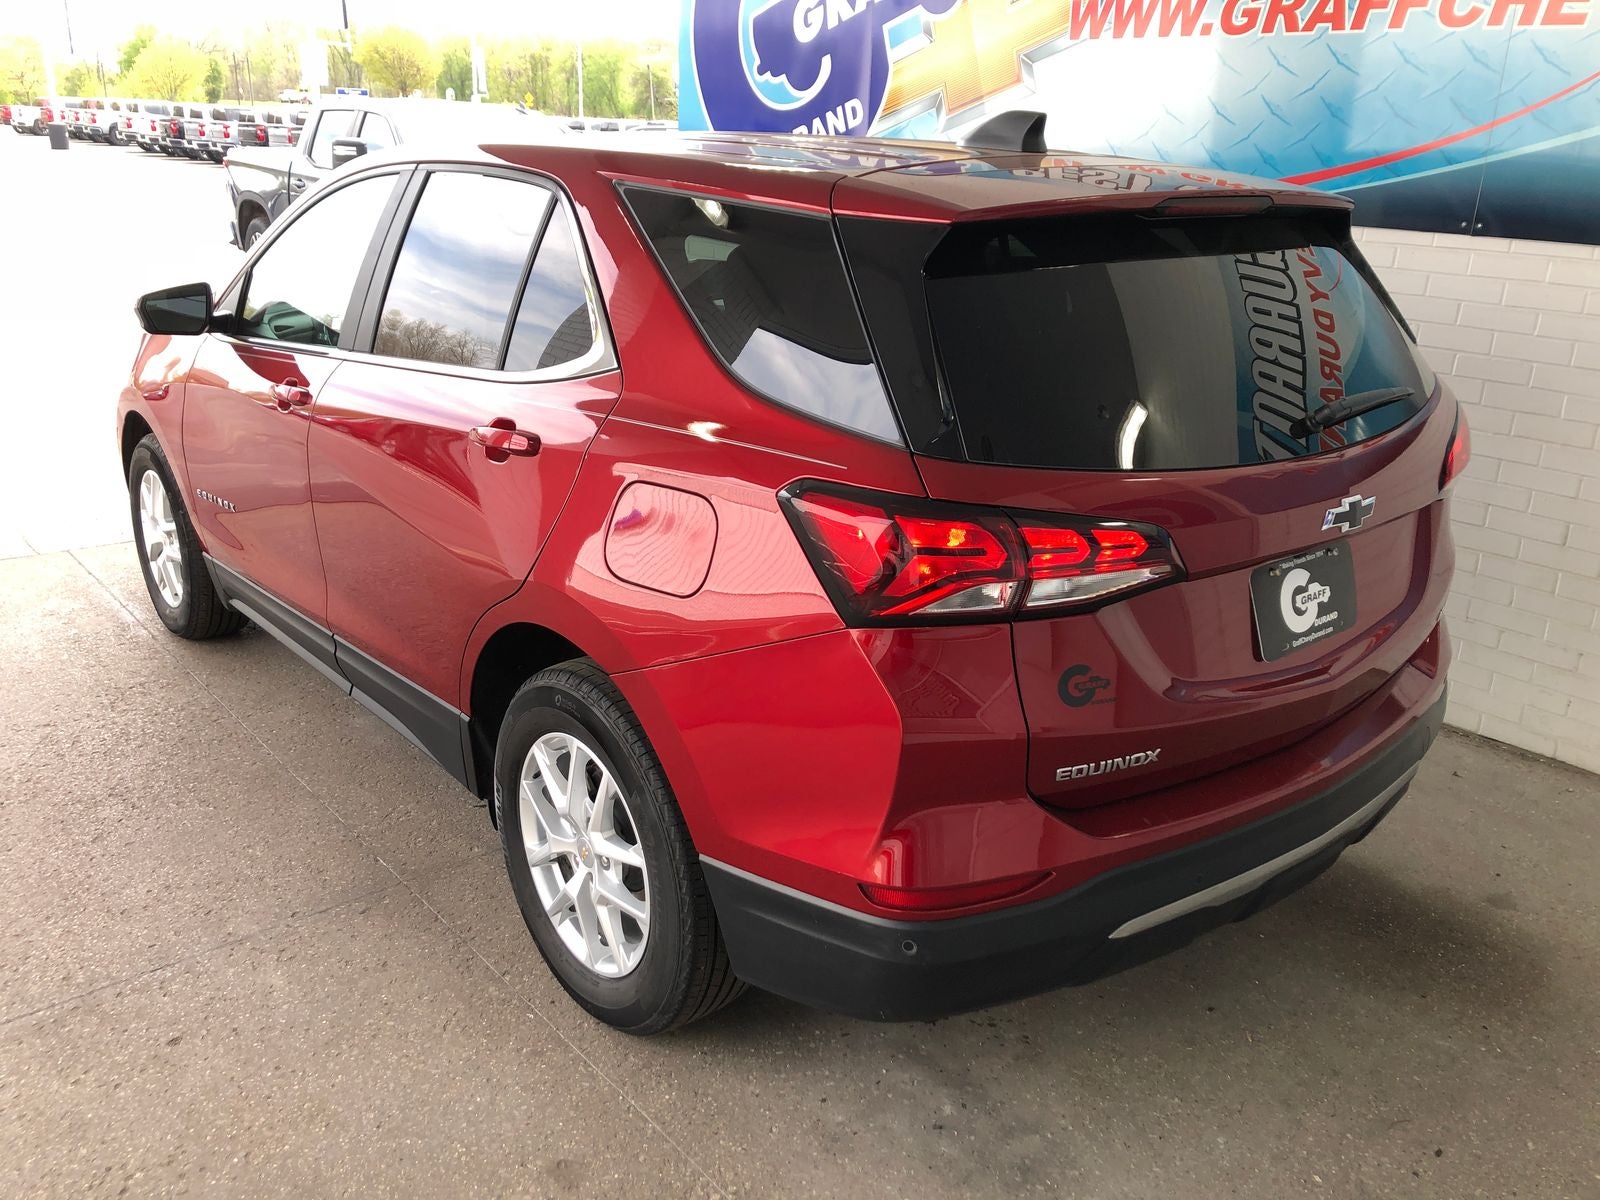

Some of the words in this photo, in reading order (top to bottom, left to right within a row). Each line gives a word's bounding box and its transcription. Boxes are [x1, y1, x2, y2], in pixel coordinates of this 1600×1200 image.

[196, 488, 238, 513] EQUINOX
[1301, 588, 1327, 605] GRAFF
[1314, 611, 1338, 627] DURAND
[1055, 748, 1161, 782] EQUINOX
